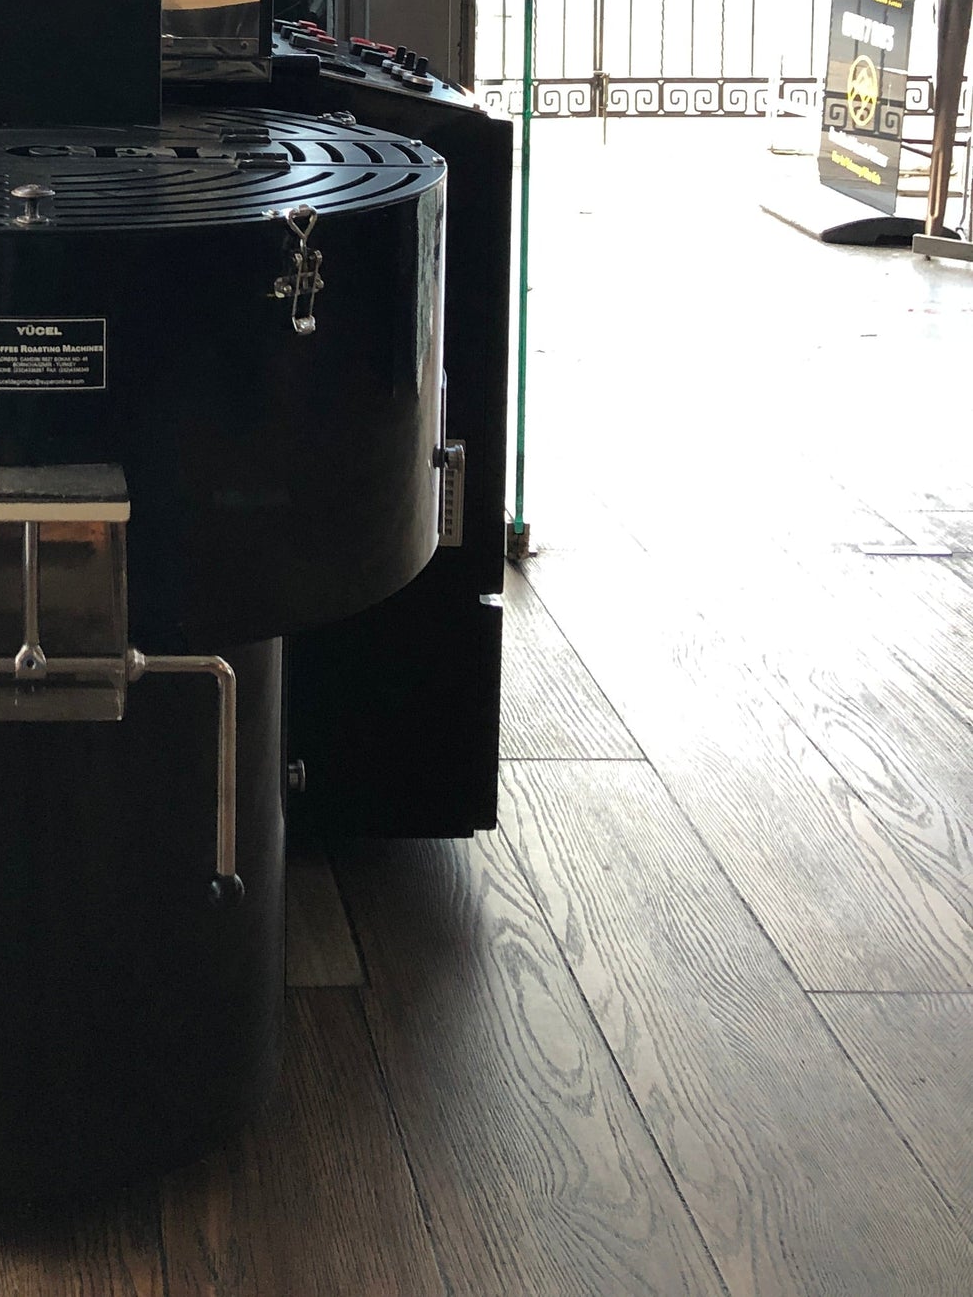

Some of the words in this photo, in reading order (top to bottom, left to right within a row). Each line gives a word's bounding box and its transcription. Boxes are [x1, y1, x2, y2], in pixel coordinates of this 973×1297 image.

[16, 325, 63, 336] YÜCEL
[20, 345, 61, 353] ROASTING
[62, 345, 104, 353] MACHINES
